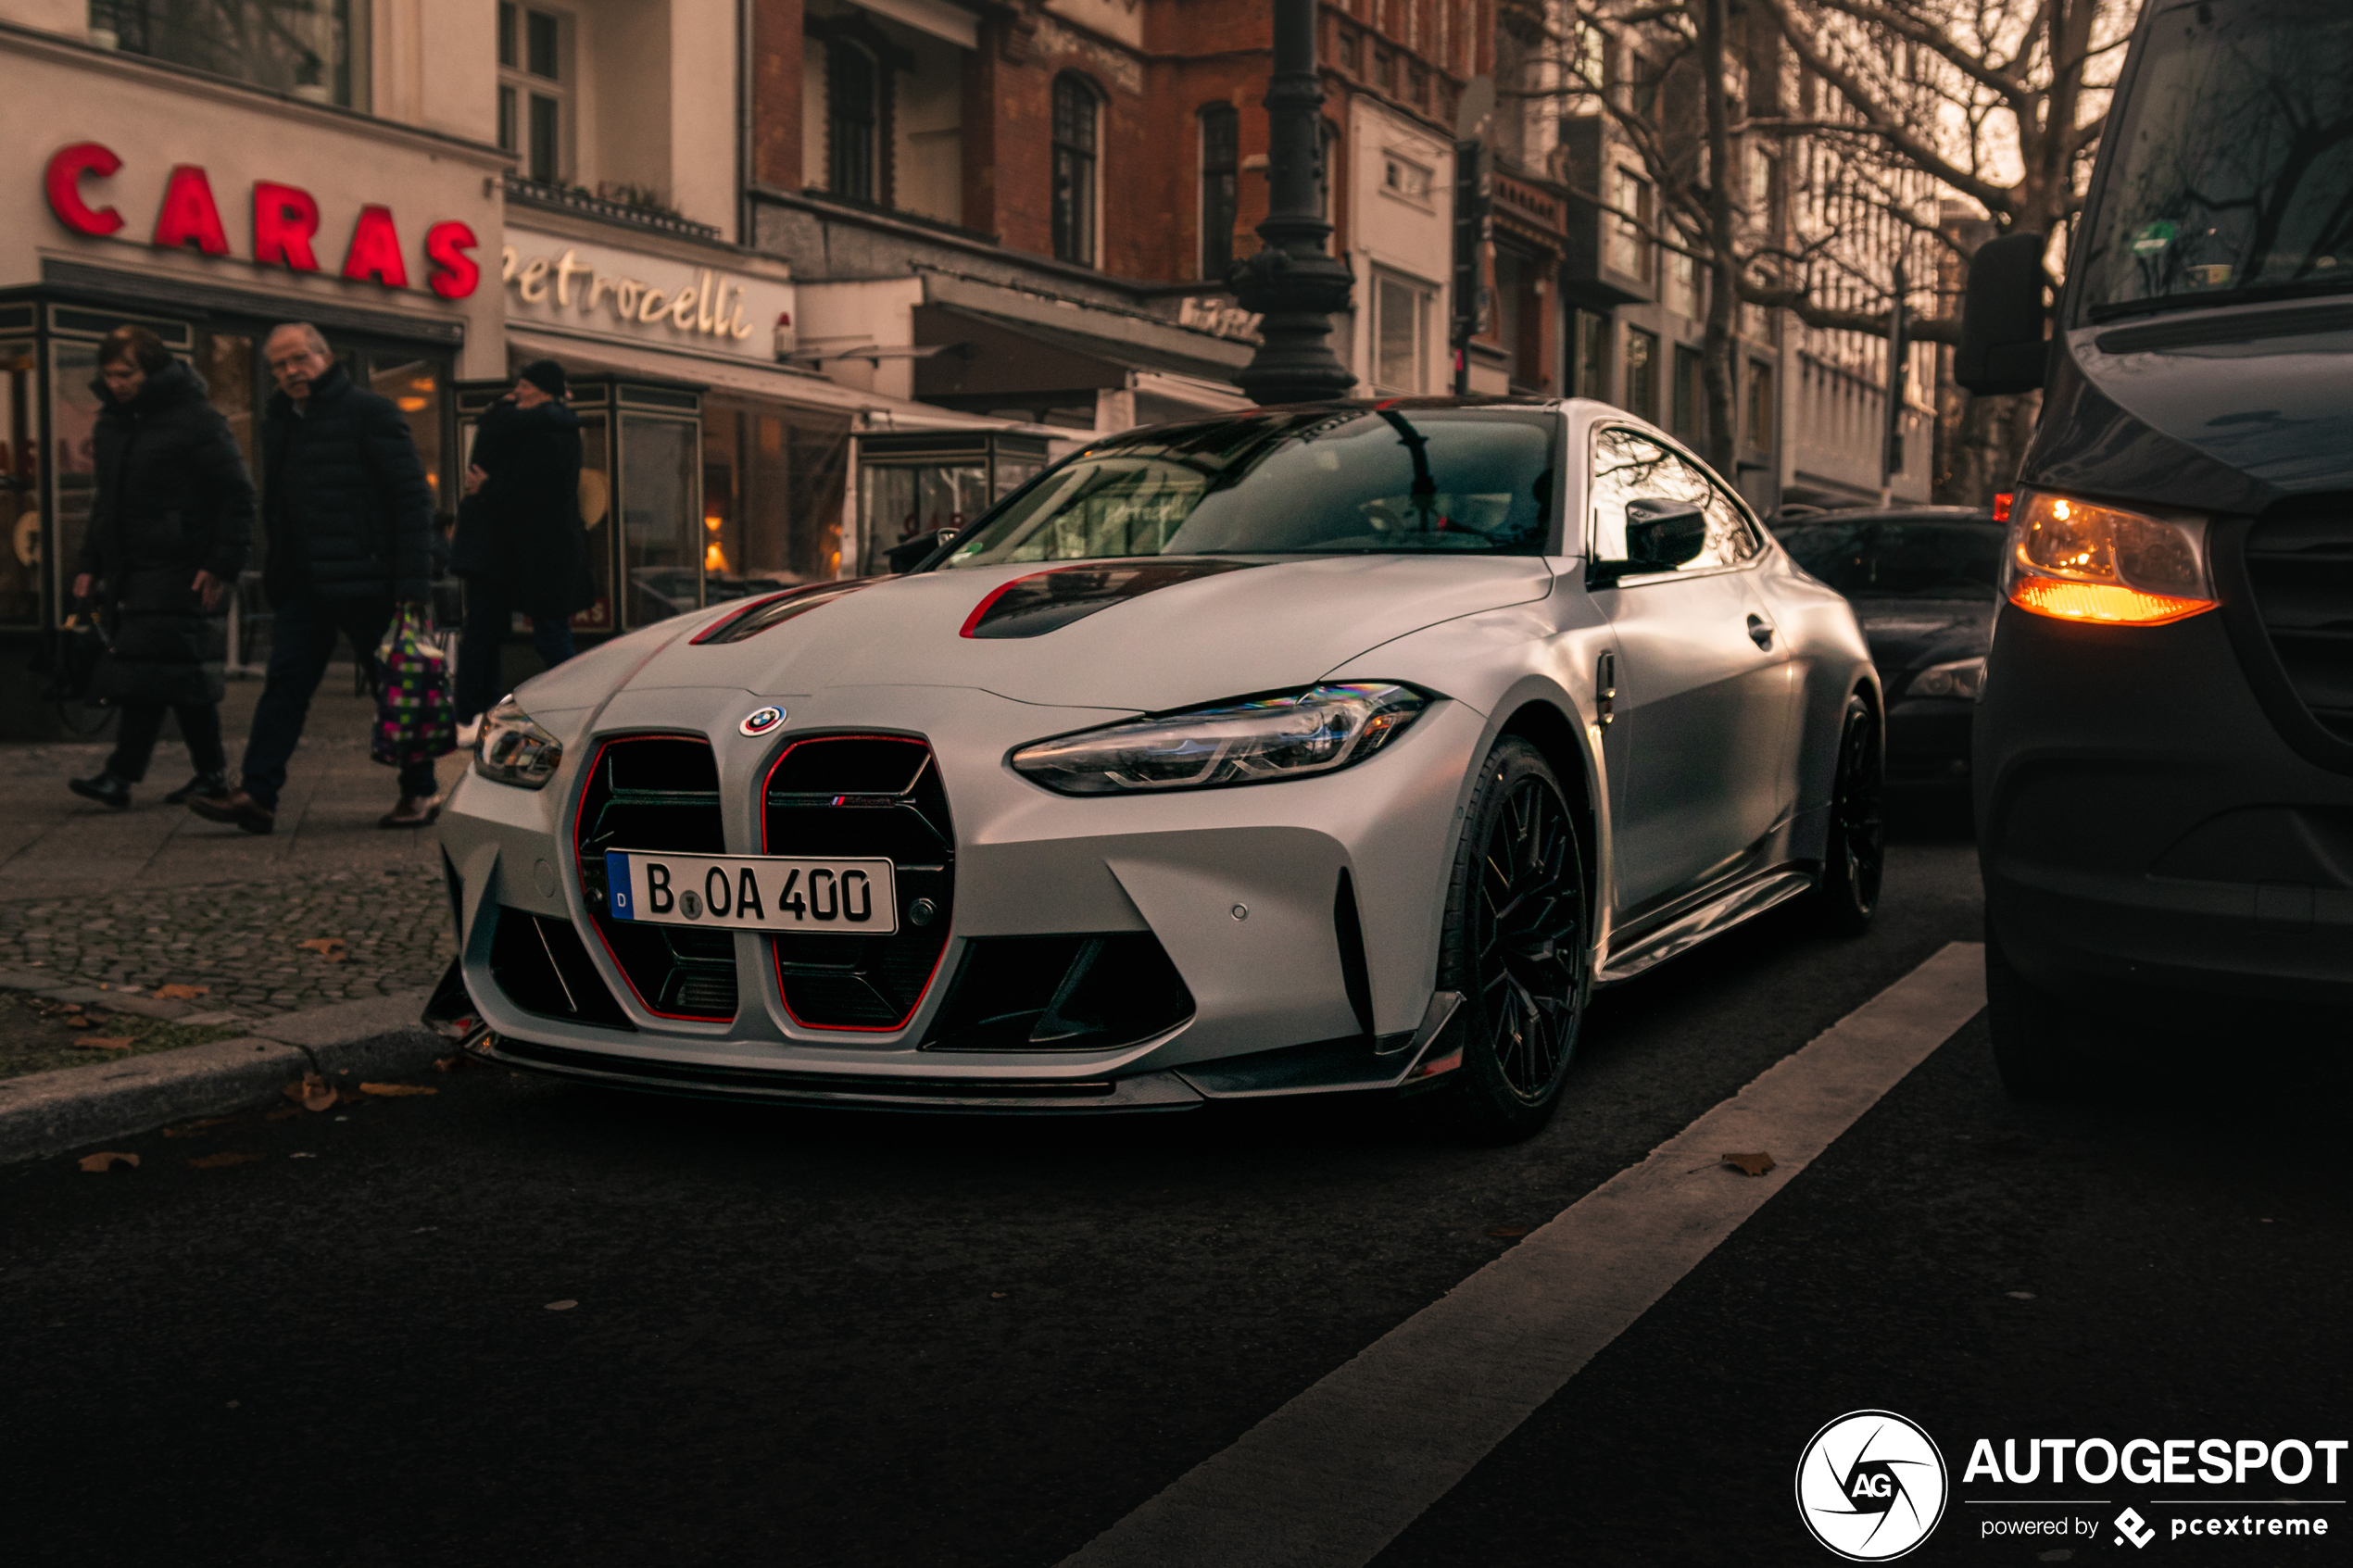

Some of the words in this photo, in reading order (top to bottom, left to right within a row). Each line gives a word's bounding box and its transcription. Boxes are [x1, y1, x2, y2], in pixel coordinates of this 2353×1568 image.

[45, 142, 481, 299] CARAS
[617, 892, 626, 908] D
[647, 862, 674, 914] B
[705, 866, 765, 921] OA
[779, 868, 873, 922] 400
